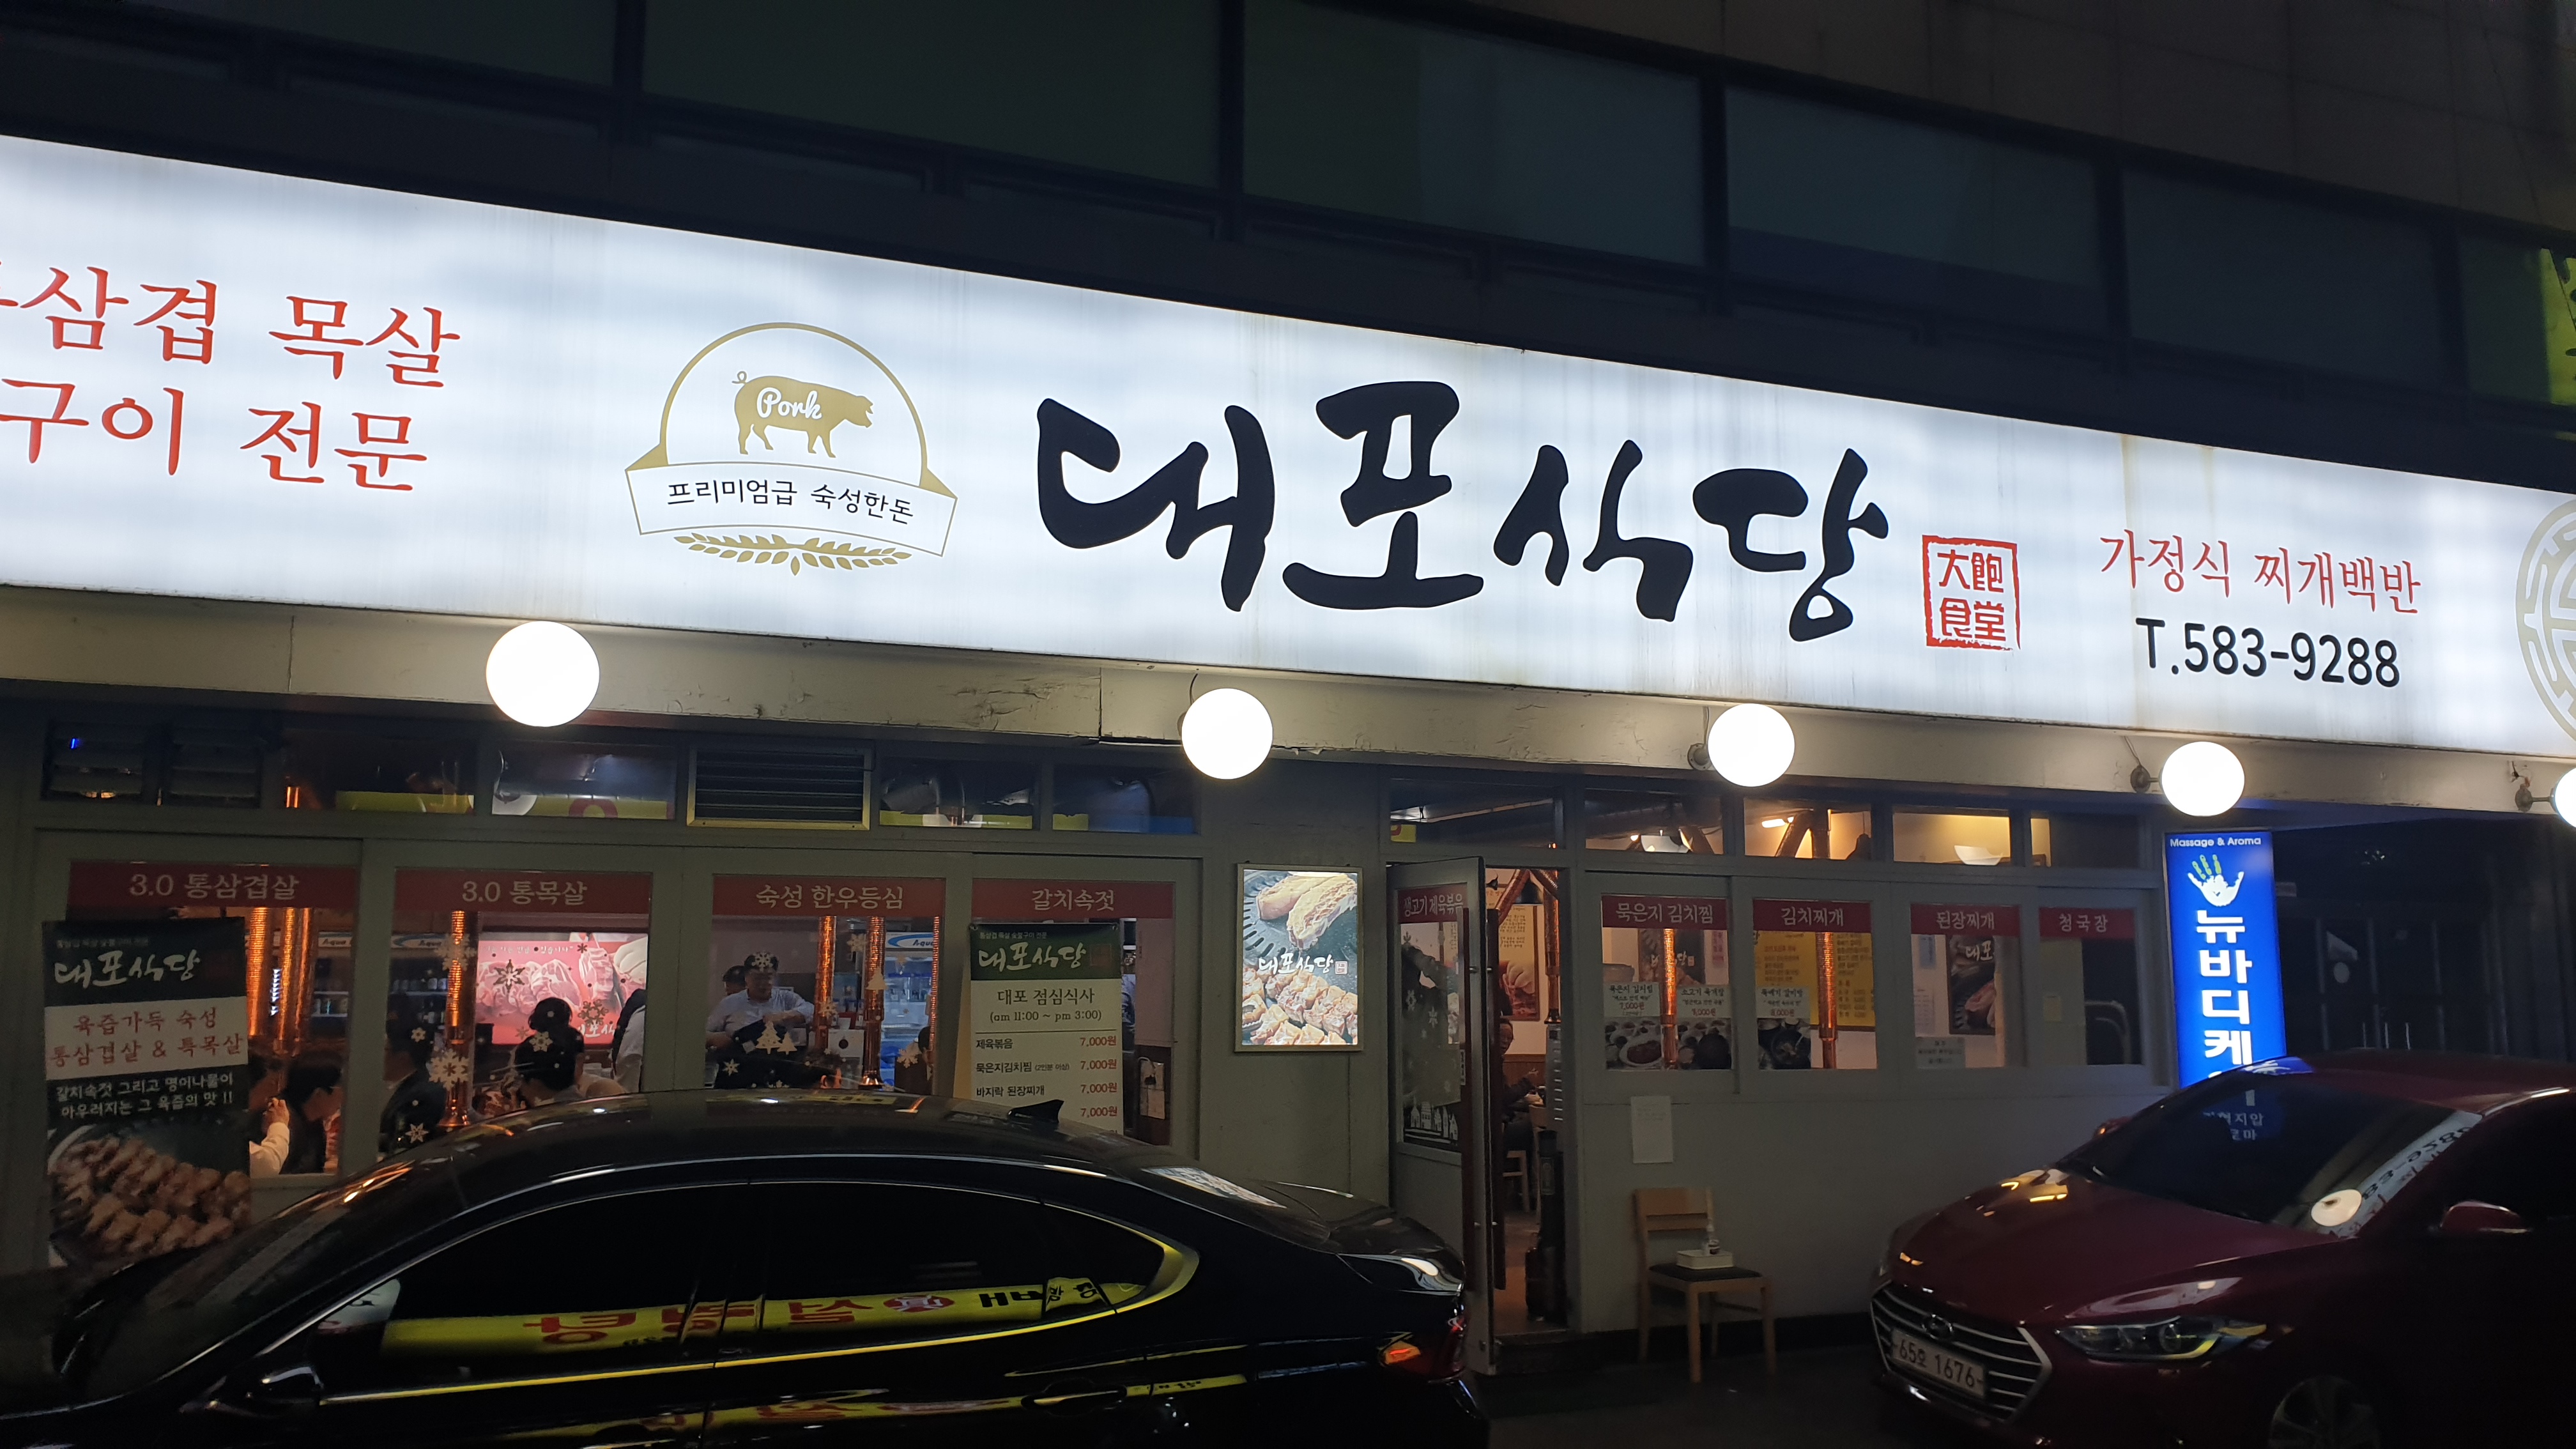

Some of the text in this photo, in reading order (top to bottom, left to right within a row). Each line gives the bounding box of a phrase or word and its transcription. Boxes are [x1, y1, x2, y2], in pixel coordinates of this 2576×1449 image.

[0, 261, 461, 388] 삼겹 목살
[756, 387, 823, 420] Pork
[0, 378, 427, 491] 구이 전문
[667, 479, 914, 525] 프리미엄급 숙성한돈
[1037, 380, 1889, 642] 대포식당
[2099, 528, 2422, 615] 가정식 찌개백반
[2135, 617, 2401, 689] T.583-9288
[2170, 836, 2262, 848] Massage & Aroma
[130, 873, 300, 900] 3.0 통삼겹살
[461, 881, 588, 905] 3.0 통목살
[756, 884, 905, 910] 숙성 한우등심
[1031, 888, 1115, 912] 갈치속젓
[1615, 902, 1713, 924] 묵은지 김치찜
[1781, 906, 1844, 927] 김치찌개
[1935, 910, 1995, 931] 된장찌개
[2058, 913, 2109, 933] 청국장
[54, 949, 201, 989] 대포식당
[978, 941, 1087, 972] 대포식당
[1259, 953, 1334, 975] 대포식당
[997, 988, 1095, 1006] 대포 점심식사
[2195, 909, 2254, 1080] 뉴바디케
[73, 1006, 217, 1036] 육즙가득 숙성
[51, 1039, 142, 1068] 통삼겹살
[152, 1039, 167, 1059] &
[976, 1038, 1013, 1050] 제육볶음
[118, 1078, 162, 1096] 그리고
[976, 1086, 1004, 1098] 바지락
[1007, 1085, 1045, 1097] 된장찌개
[137, 1098, 153, 1113] 그
[203, 1092, 218, 1107] 맛
[1933, 1352, 1976, 1388] 1676
